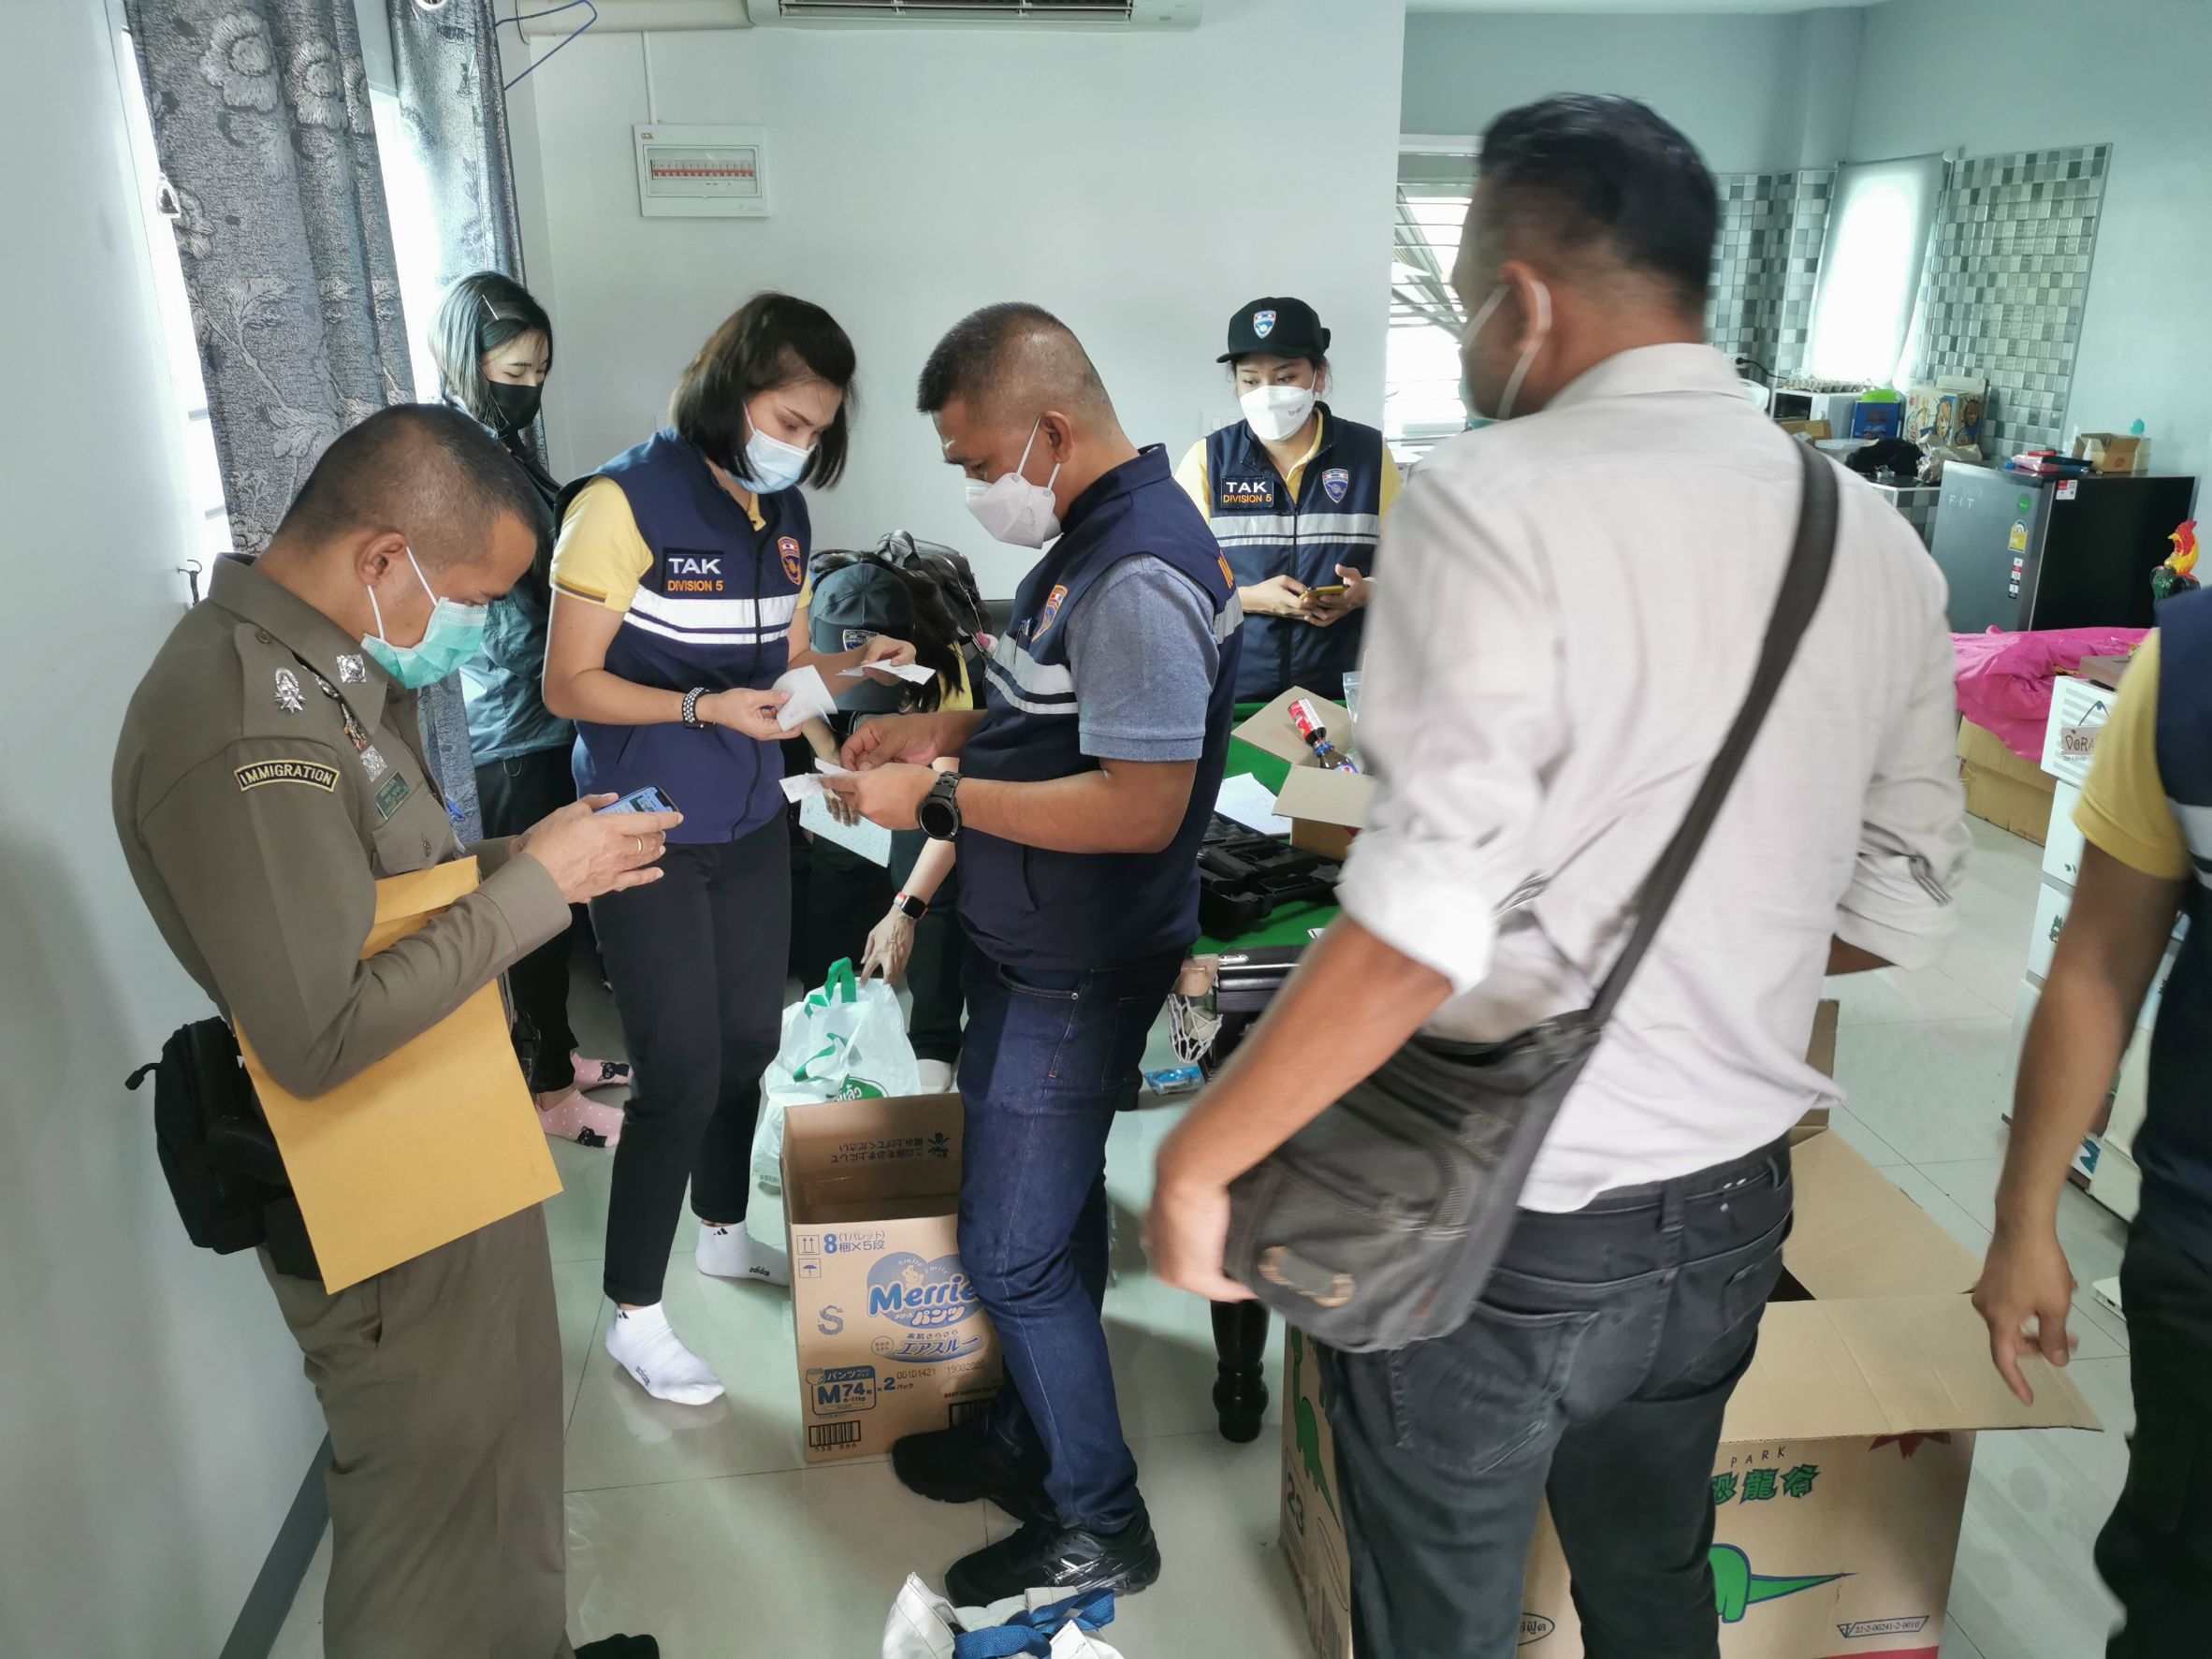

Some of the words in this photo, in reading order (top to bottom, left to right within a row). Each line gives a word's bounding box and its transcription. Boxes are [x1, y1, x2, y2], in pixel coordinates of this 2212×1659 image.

[1226, 481, 1267, 493] TAK
[1223, 494, 1262, 503] DIVISION
[1266, 493, 1273, 502] 5
[667, 558, 722, 575] TAK
[667, 580, 713, 592] DIVISION
[716, 580, 724, 591] 5
[240, 763, 334, 786] IMMIGRATION
[823, 1233, 837, 1255] 8
[869, 1274, 977, 1316] Merrie
[911, 1305, 966, 1326] パンツ
[895, 1337, 980, 1355] エアスルー
[1730, 1446, 1787, 1467] PARK
